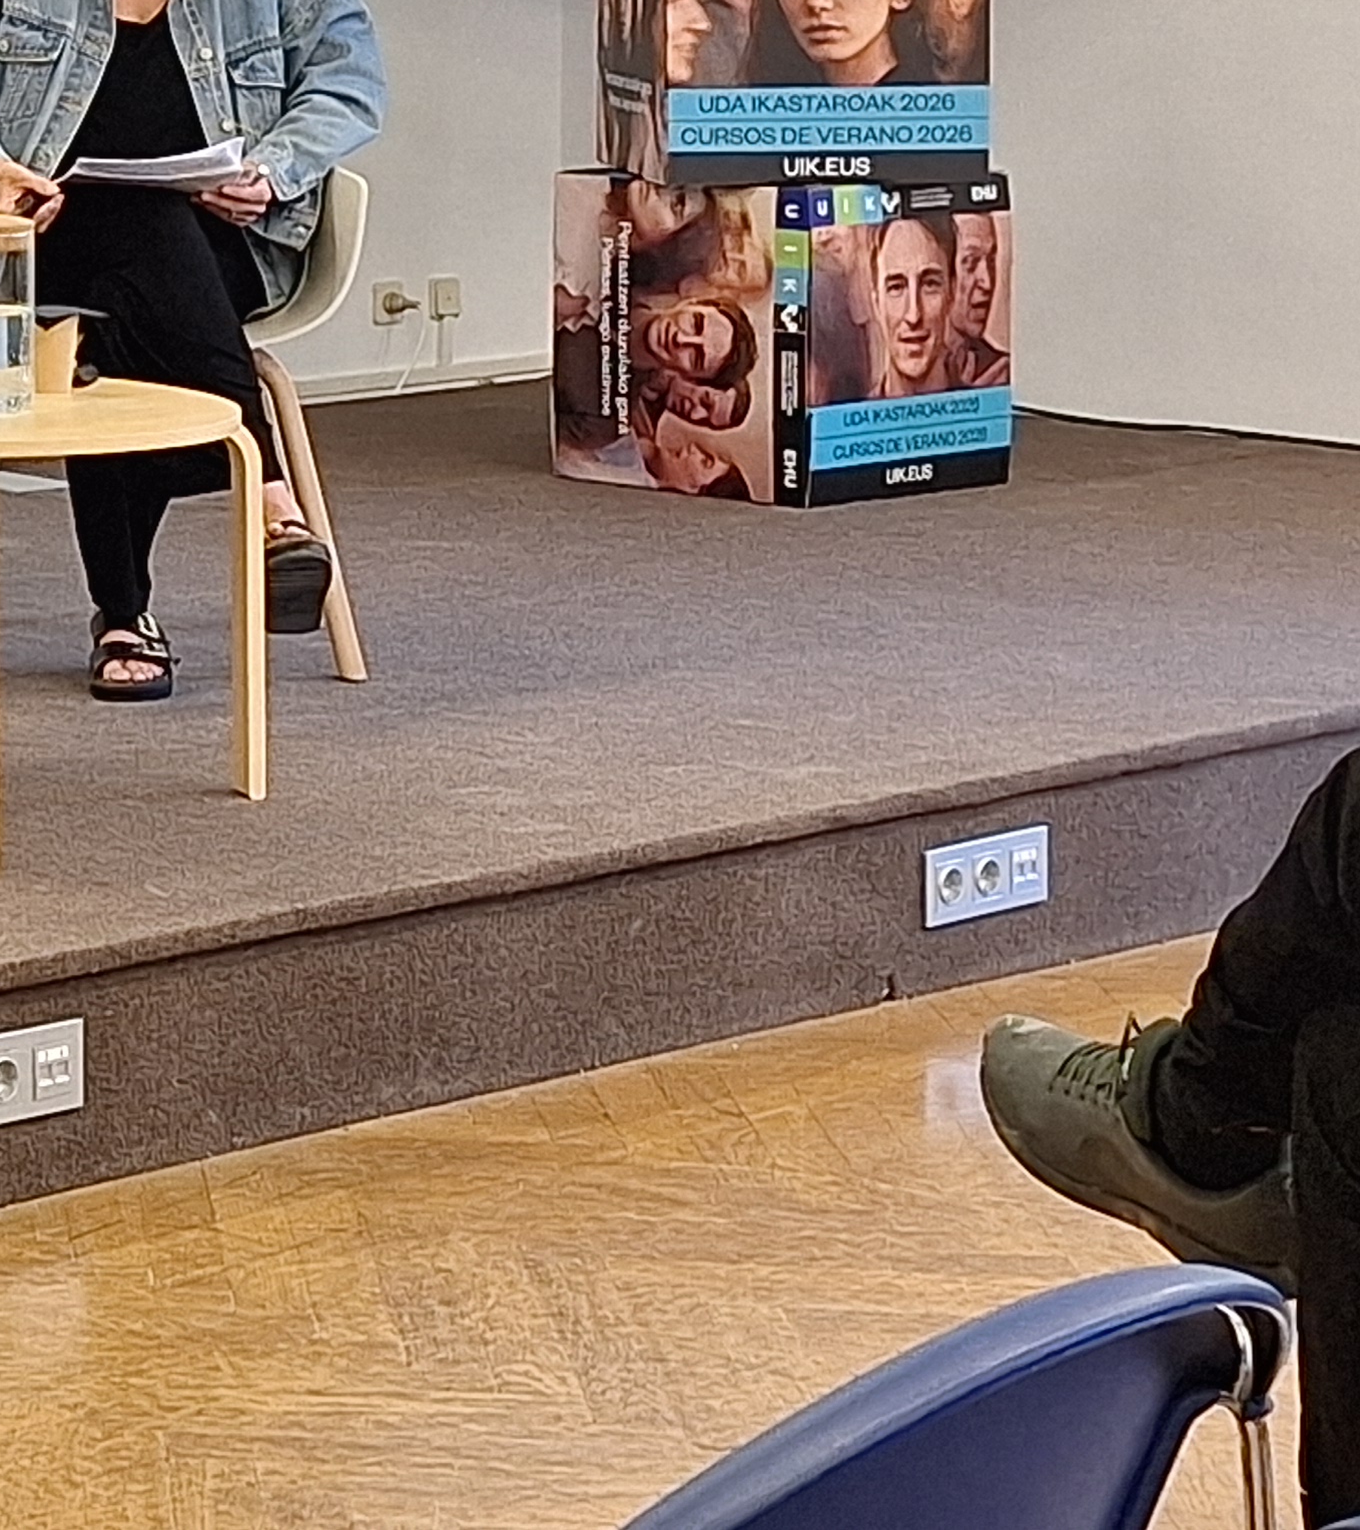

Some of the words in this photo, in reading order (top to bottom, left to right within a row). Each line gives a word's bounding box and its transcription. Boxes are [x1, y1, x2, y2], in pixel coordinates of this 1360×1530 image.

[699, 95, 746, 113] UDA
[752, 94, 896, 113] IKASTAROAK
[900, 93, 956, 112] 2026
[681, 126, 777, 145] CURSOS
[781, 127, 814, 144] DE
[815, 126, 913, 144] VERANO
[917, 125, 972, 143] 2026
[783, 156, 871, 176] UIK.EUS
[886, 438, 902, 453] DE
[904, 432, 957, 452] VERANO
